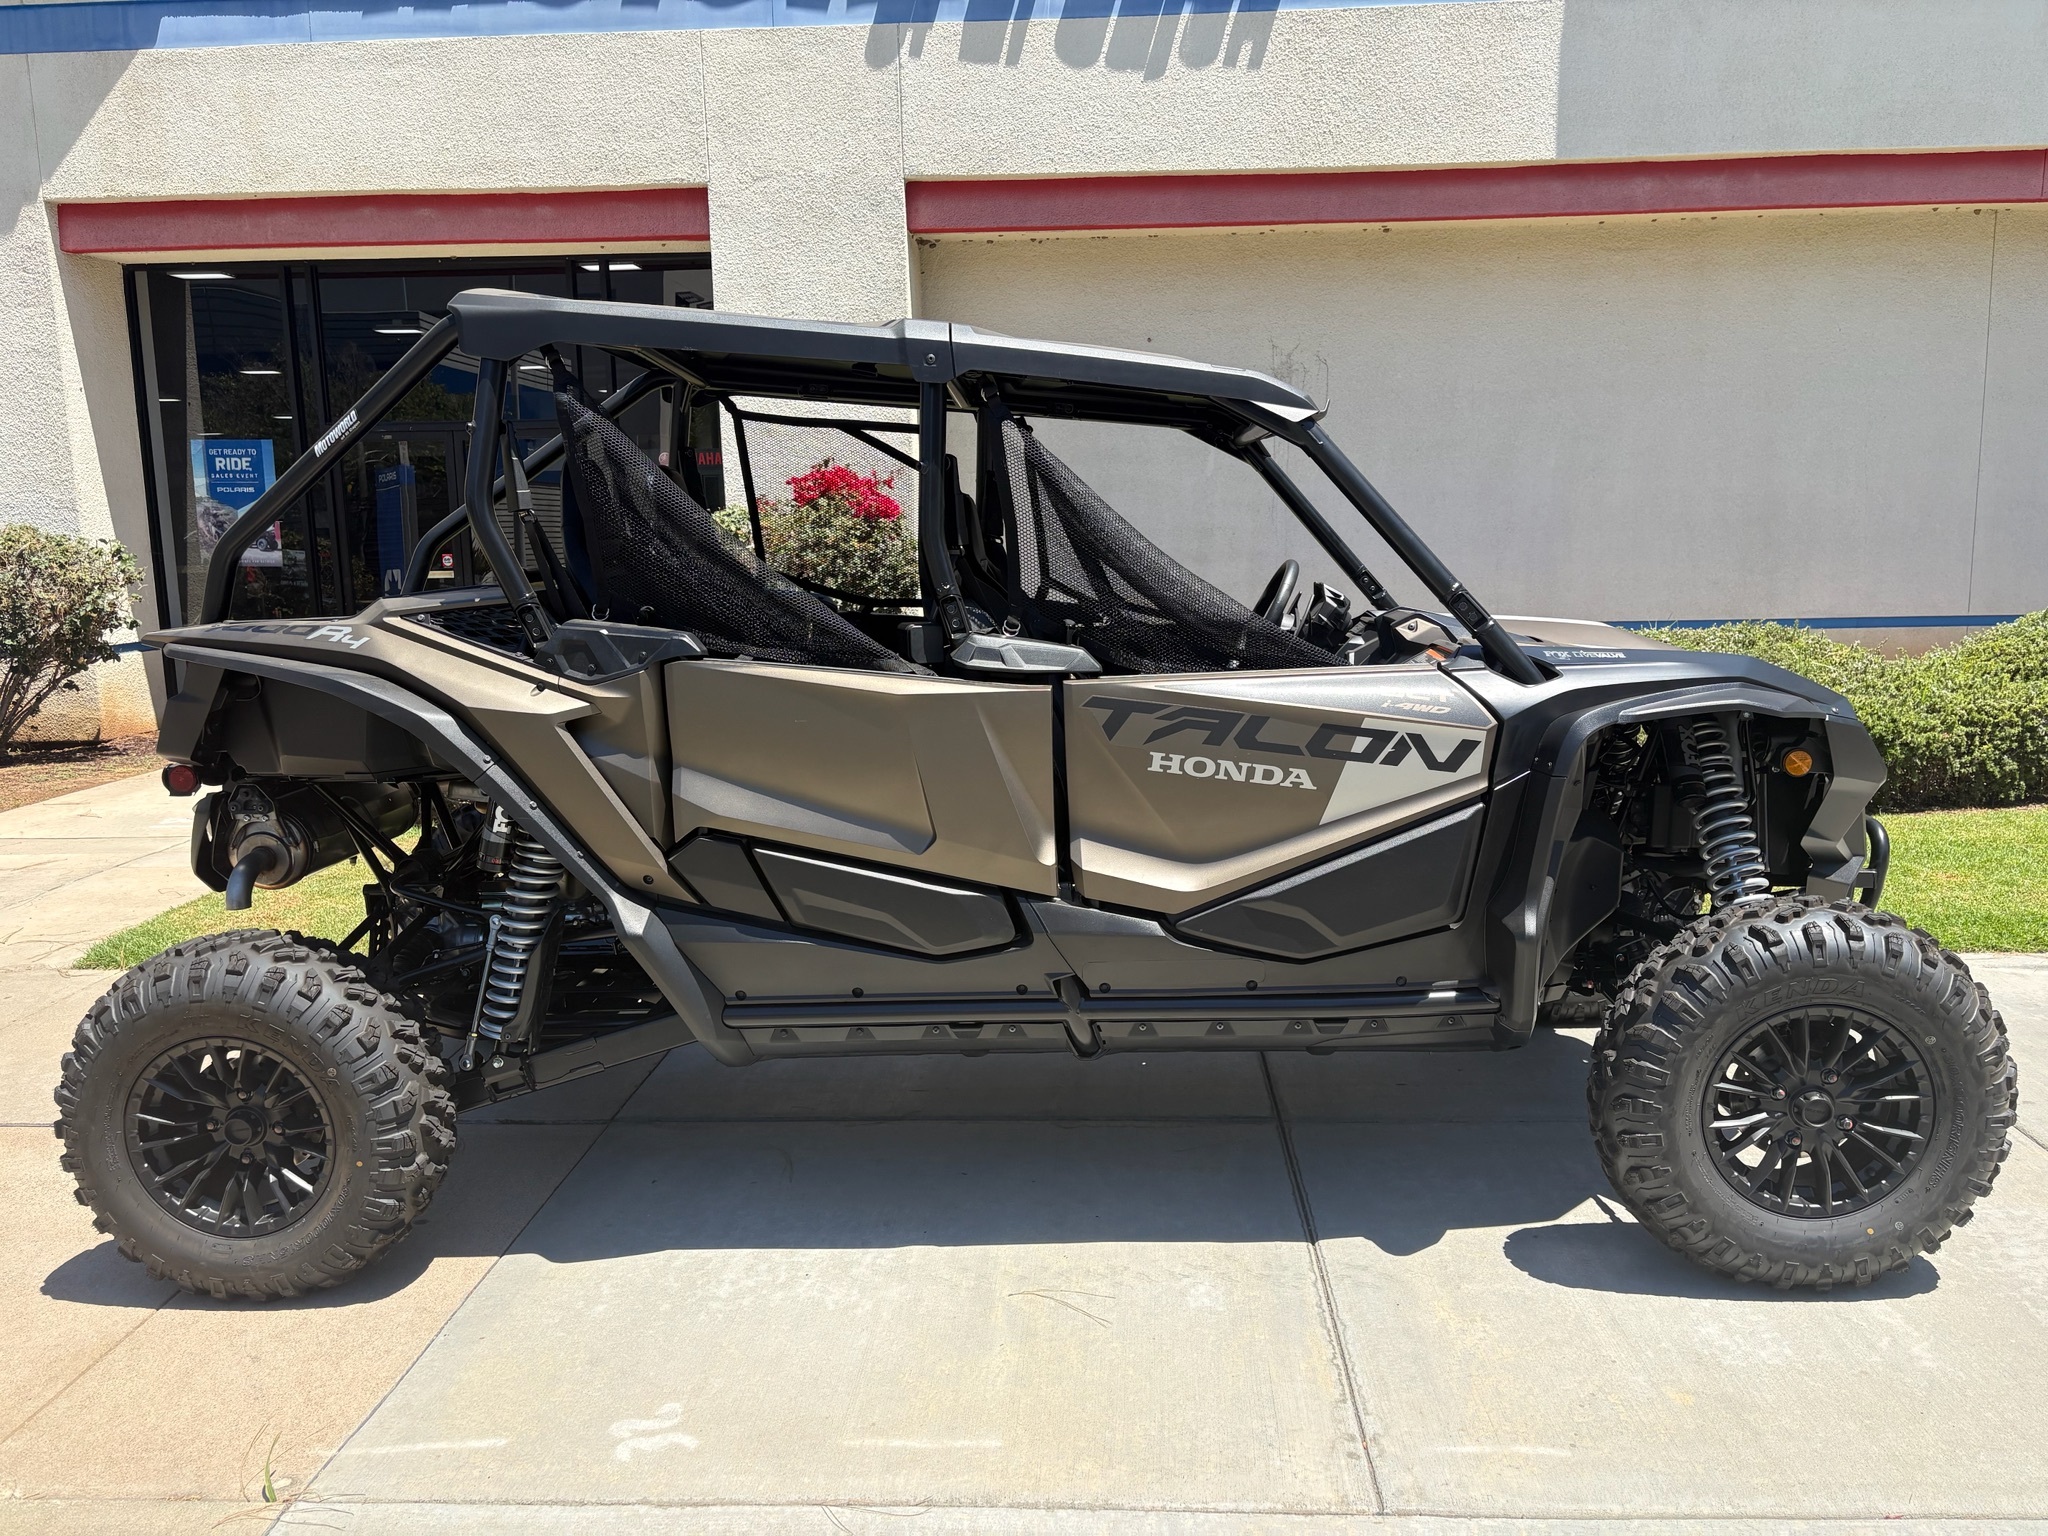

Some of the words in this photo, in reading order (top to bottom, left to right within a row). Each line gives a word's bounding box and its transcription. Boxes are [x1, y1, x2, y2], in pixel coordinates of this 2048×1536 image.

[208, 448, 222, 456] GET
[223, 448, 246, 456] READY
[246, 448, 257, 456] TO
[215, 457, 253, 471] RIDE
[696, 452, 723, 465] AHA
[1080, 694, 1482, 774] TALON
[1147, 751, 1318, 791] HONDA
[1735, 976, 1867, 1023] KENDA
